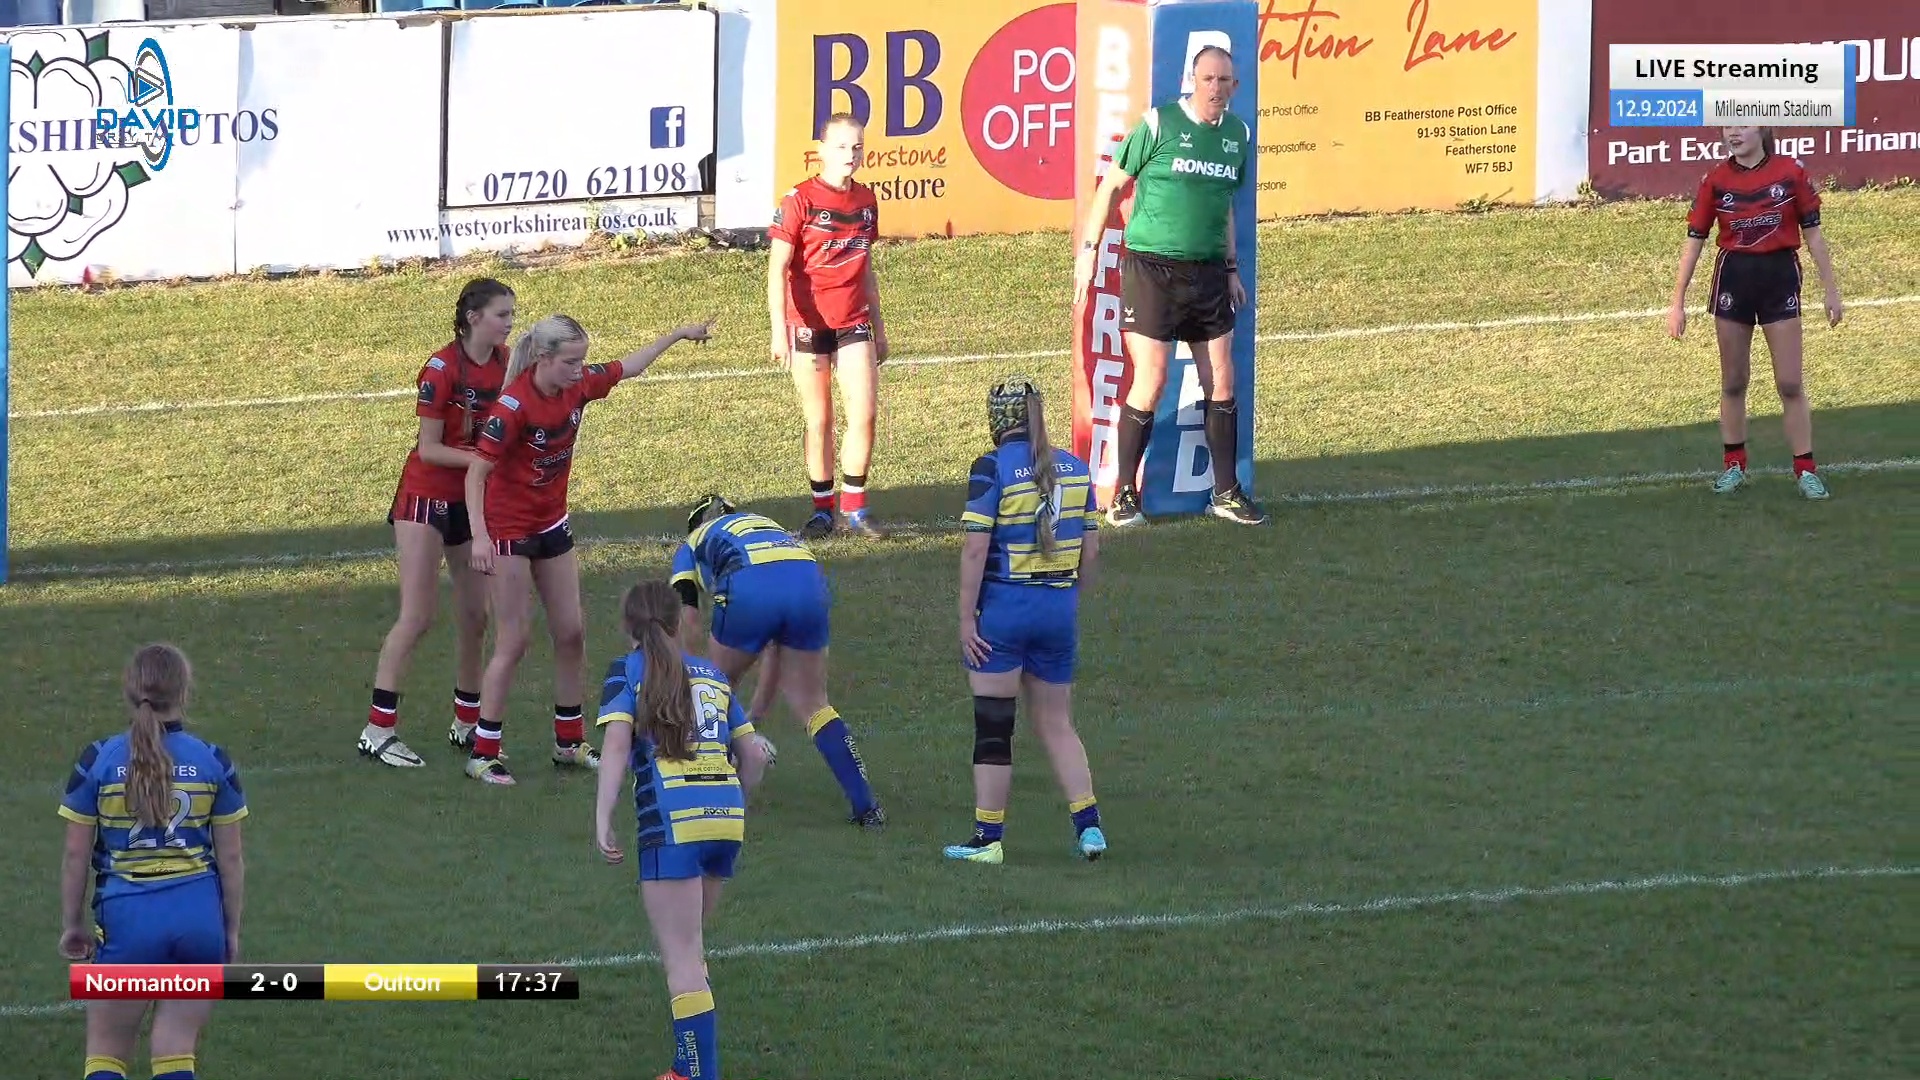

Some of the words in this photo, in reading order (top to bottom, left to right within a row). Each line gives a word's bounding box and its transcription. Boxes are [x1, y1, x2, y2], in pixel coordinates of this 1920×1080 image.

[1404, 0, 1518, 72] Lane
[811, 29, 943, 142] BB
[1272, 106, 1292, 117] Post
[1294, 104, 1319, 117] Office
[1365, 111, 1381, 122] BB
[1384, 108, 1455, 121] Featherstone
[1458, 106, 1482, 117] Post
[1485, 104, 1518, 116] Office
[9, 117, 138, 154] SHIRE
[1417, 127, 1446, 138] 91-93
[1449, 125, 1487, 137] Station
[1490, 124, 1517, 135] Lane
[804, 145, 946, 172] Ferstone
[1445, 143, 1517, 156] Featherstone
[1608, 140, 1671, 165] Part
[1681, 137, 1815, 161] Excge
[1840, 129, 1920, 153] Finan
[1171, 157, 1238, 180] RONSEAL
[1465, 162, 1490, 174] WF7
[1492, 161, 1513, 173] 5BJ
[483, 168, 568, 202] 07720
[586, 162, 687, 197] 621198
[690, 683, 719, 739] 6
